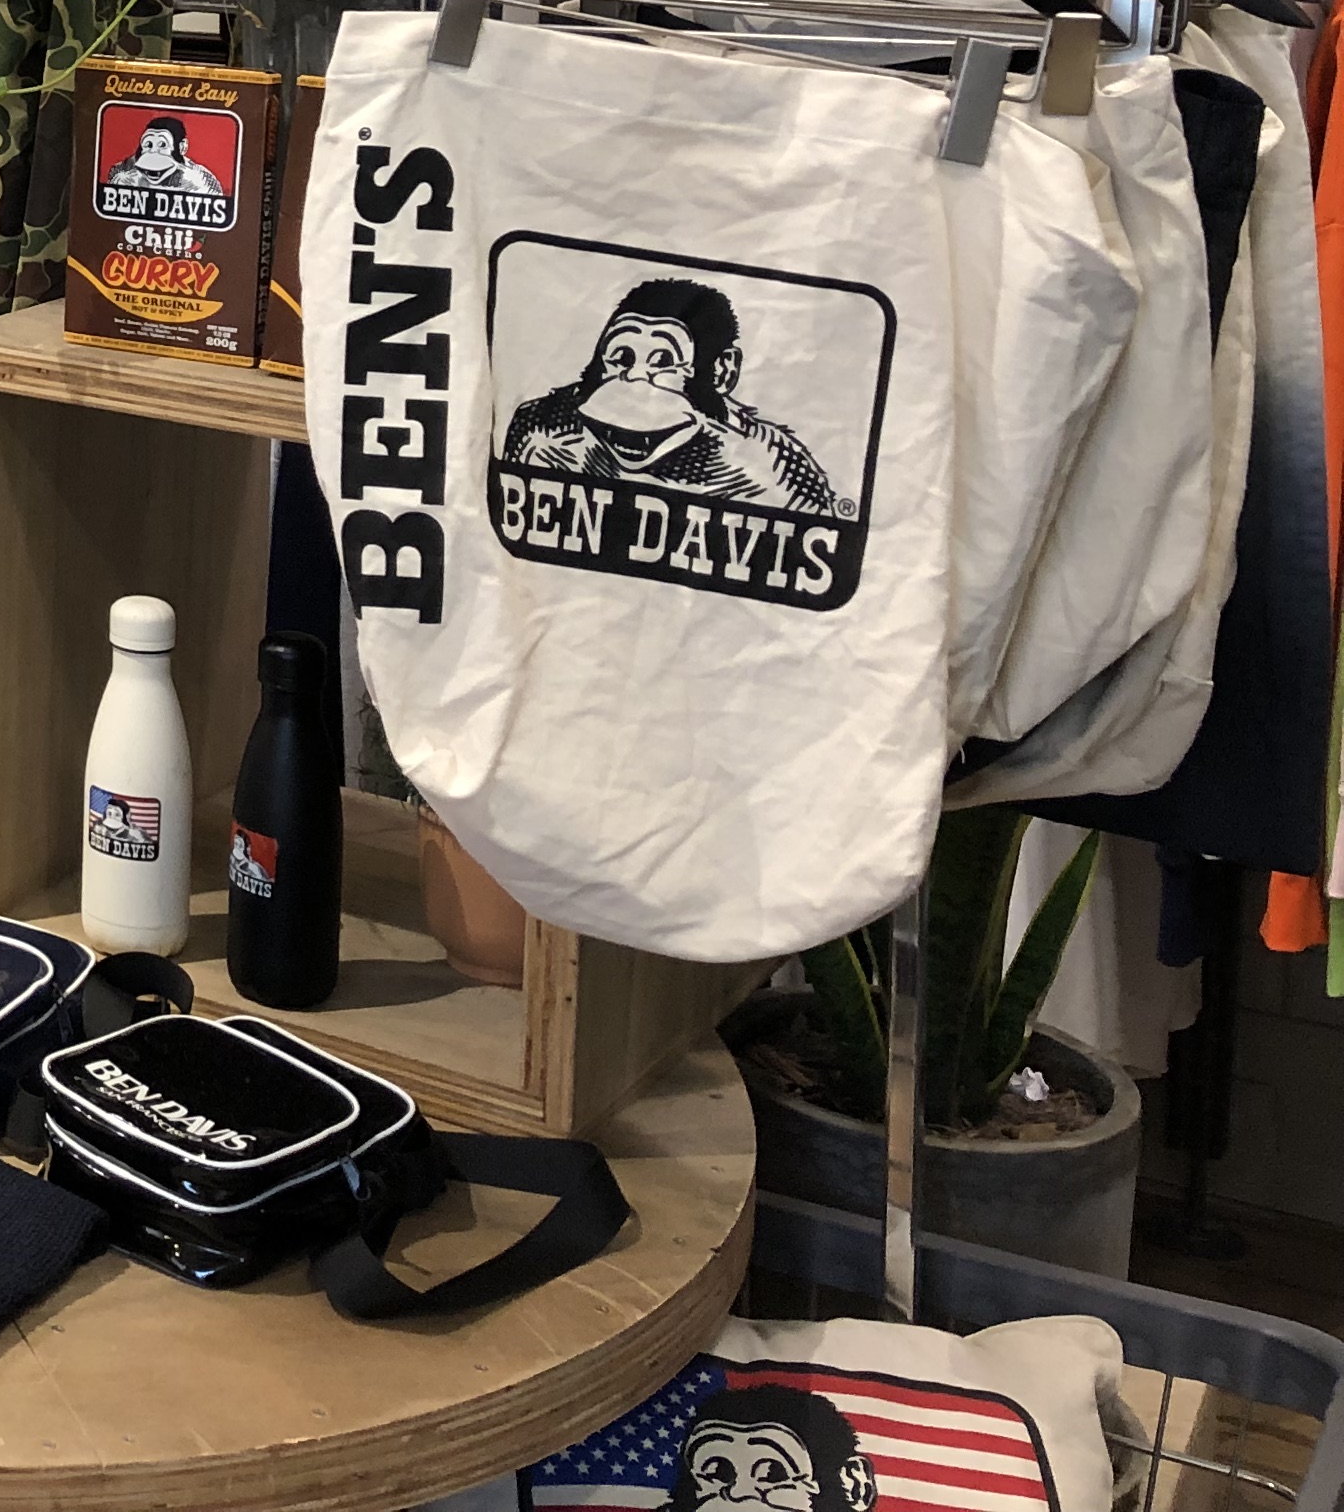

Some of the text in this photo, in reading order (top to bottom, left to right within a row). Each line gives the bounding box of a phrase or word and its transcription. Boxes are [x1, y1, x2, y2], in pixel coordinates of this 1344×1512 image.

[104, 74, 239, 108] Quick and Easy
[102, 186, 227, 224] BEN DAVIS
[116, 242, 144, 253] con
[124, 225, 194, 251] Chili
[102, 250, 221, 298] CURRY
[113, 292, 204, 313] THE ORIGINAL
[205, 336, 238, 352] 200g
[341, 145, 454, 625] BEN'S
[499, 473, 839, 596] BEN DAVIS
[90, 831, 156, 860] BEN DAVIS
[236, 872, 273, 899] DAVIS
[84, 1058, 258, 1151] BEN DAVIS
[95, 1085, 126, 1102] SAN
